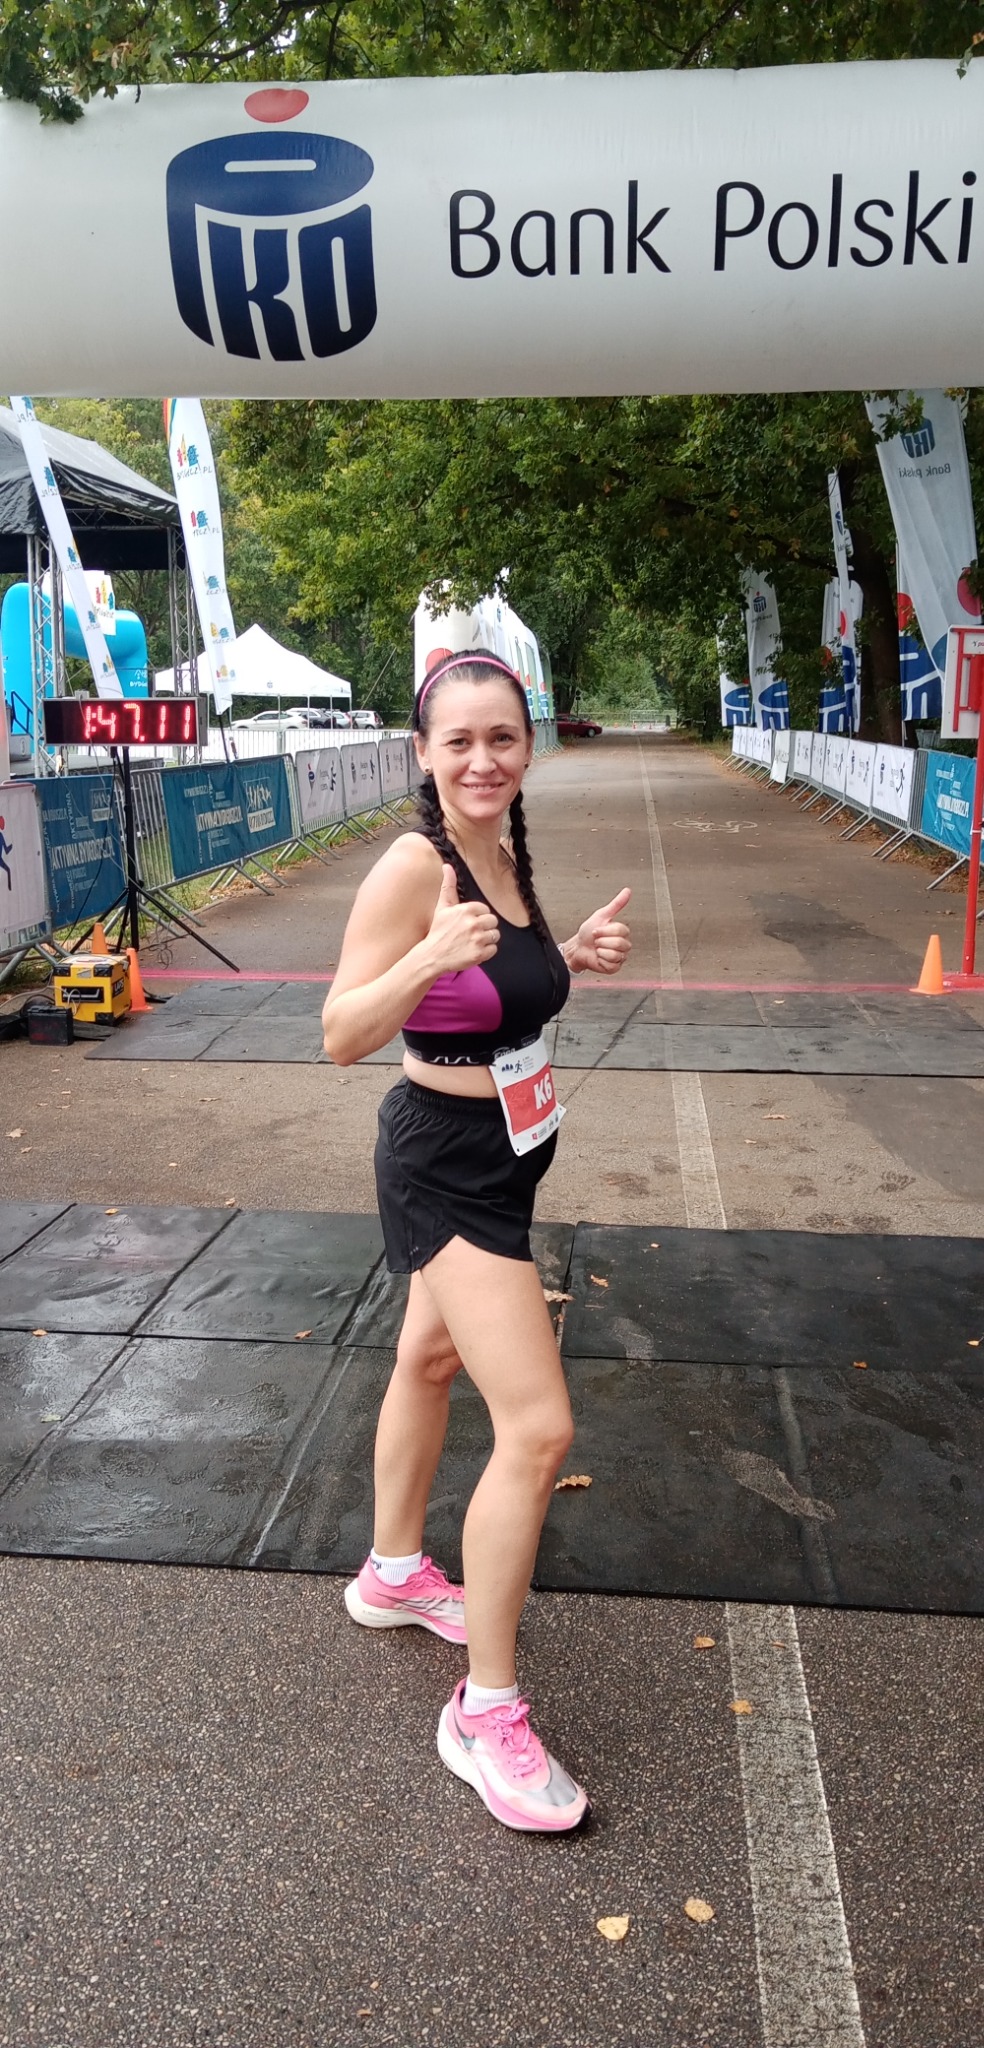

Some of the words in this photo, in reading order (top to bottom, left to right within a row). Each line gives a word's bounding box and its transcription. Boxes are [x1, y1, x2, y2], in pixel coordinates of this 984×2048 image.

[449, 179, 672, 279] Bank
[713, 170, 978, 273] Polski
[85, 704, 192, 742] 1:47.11
[533, 1072, 553, 1110] K6
